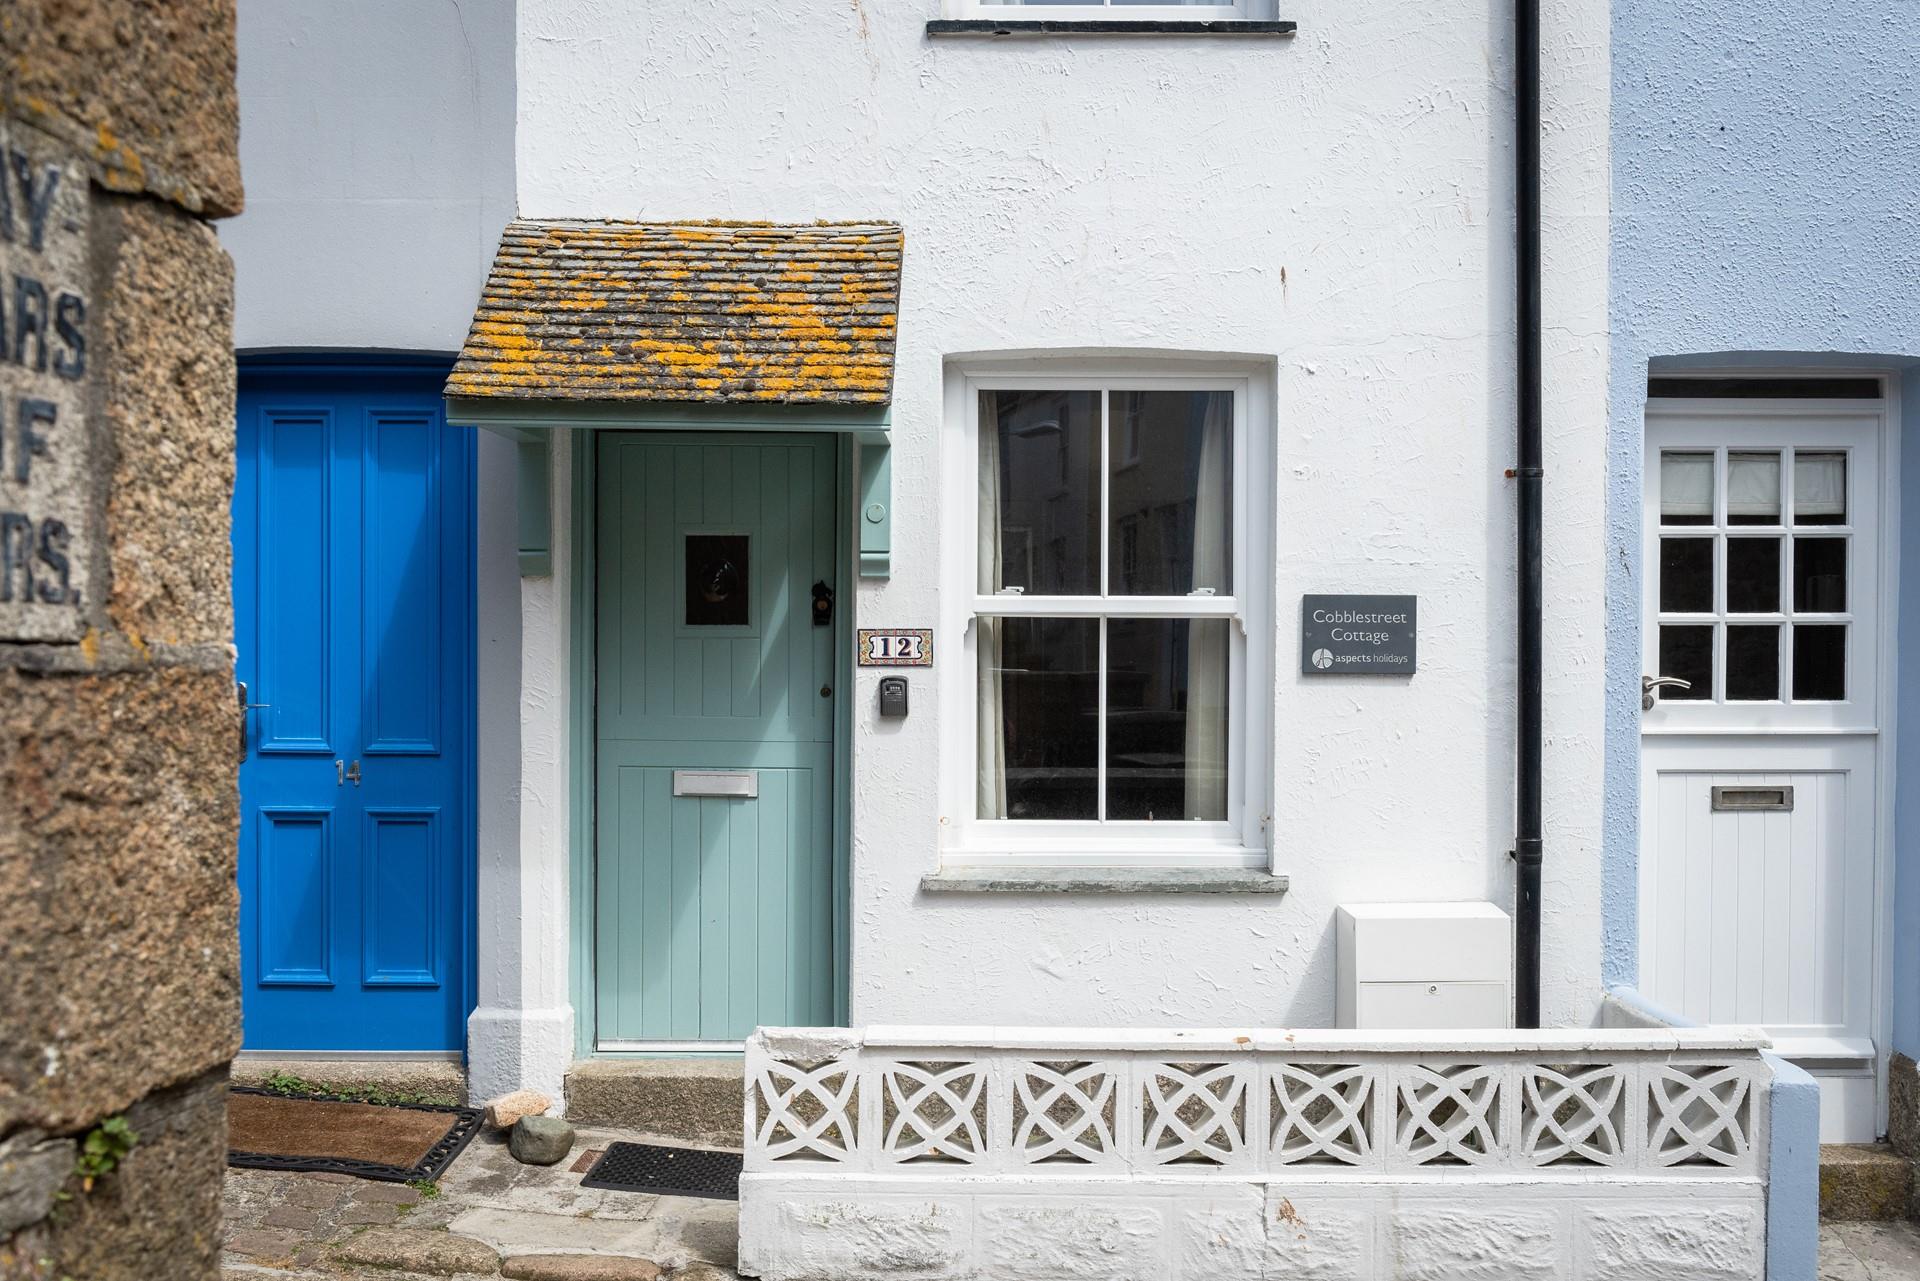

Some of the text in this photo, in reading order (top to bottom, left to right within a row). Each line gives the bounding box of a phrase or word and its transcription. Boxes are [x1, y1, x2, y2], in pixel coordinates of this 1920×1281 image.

[1313, 609, 1407, 624] Cobblestreet
[1331, 627, 1389, 645] Cottage
[880, 637, 912, 657] 12
[1335, 653, 1408, 664] aspects holidays
[335, 759, 361, 785] 14
